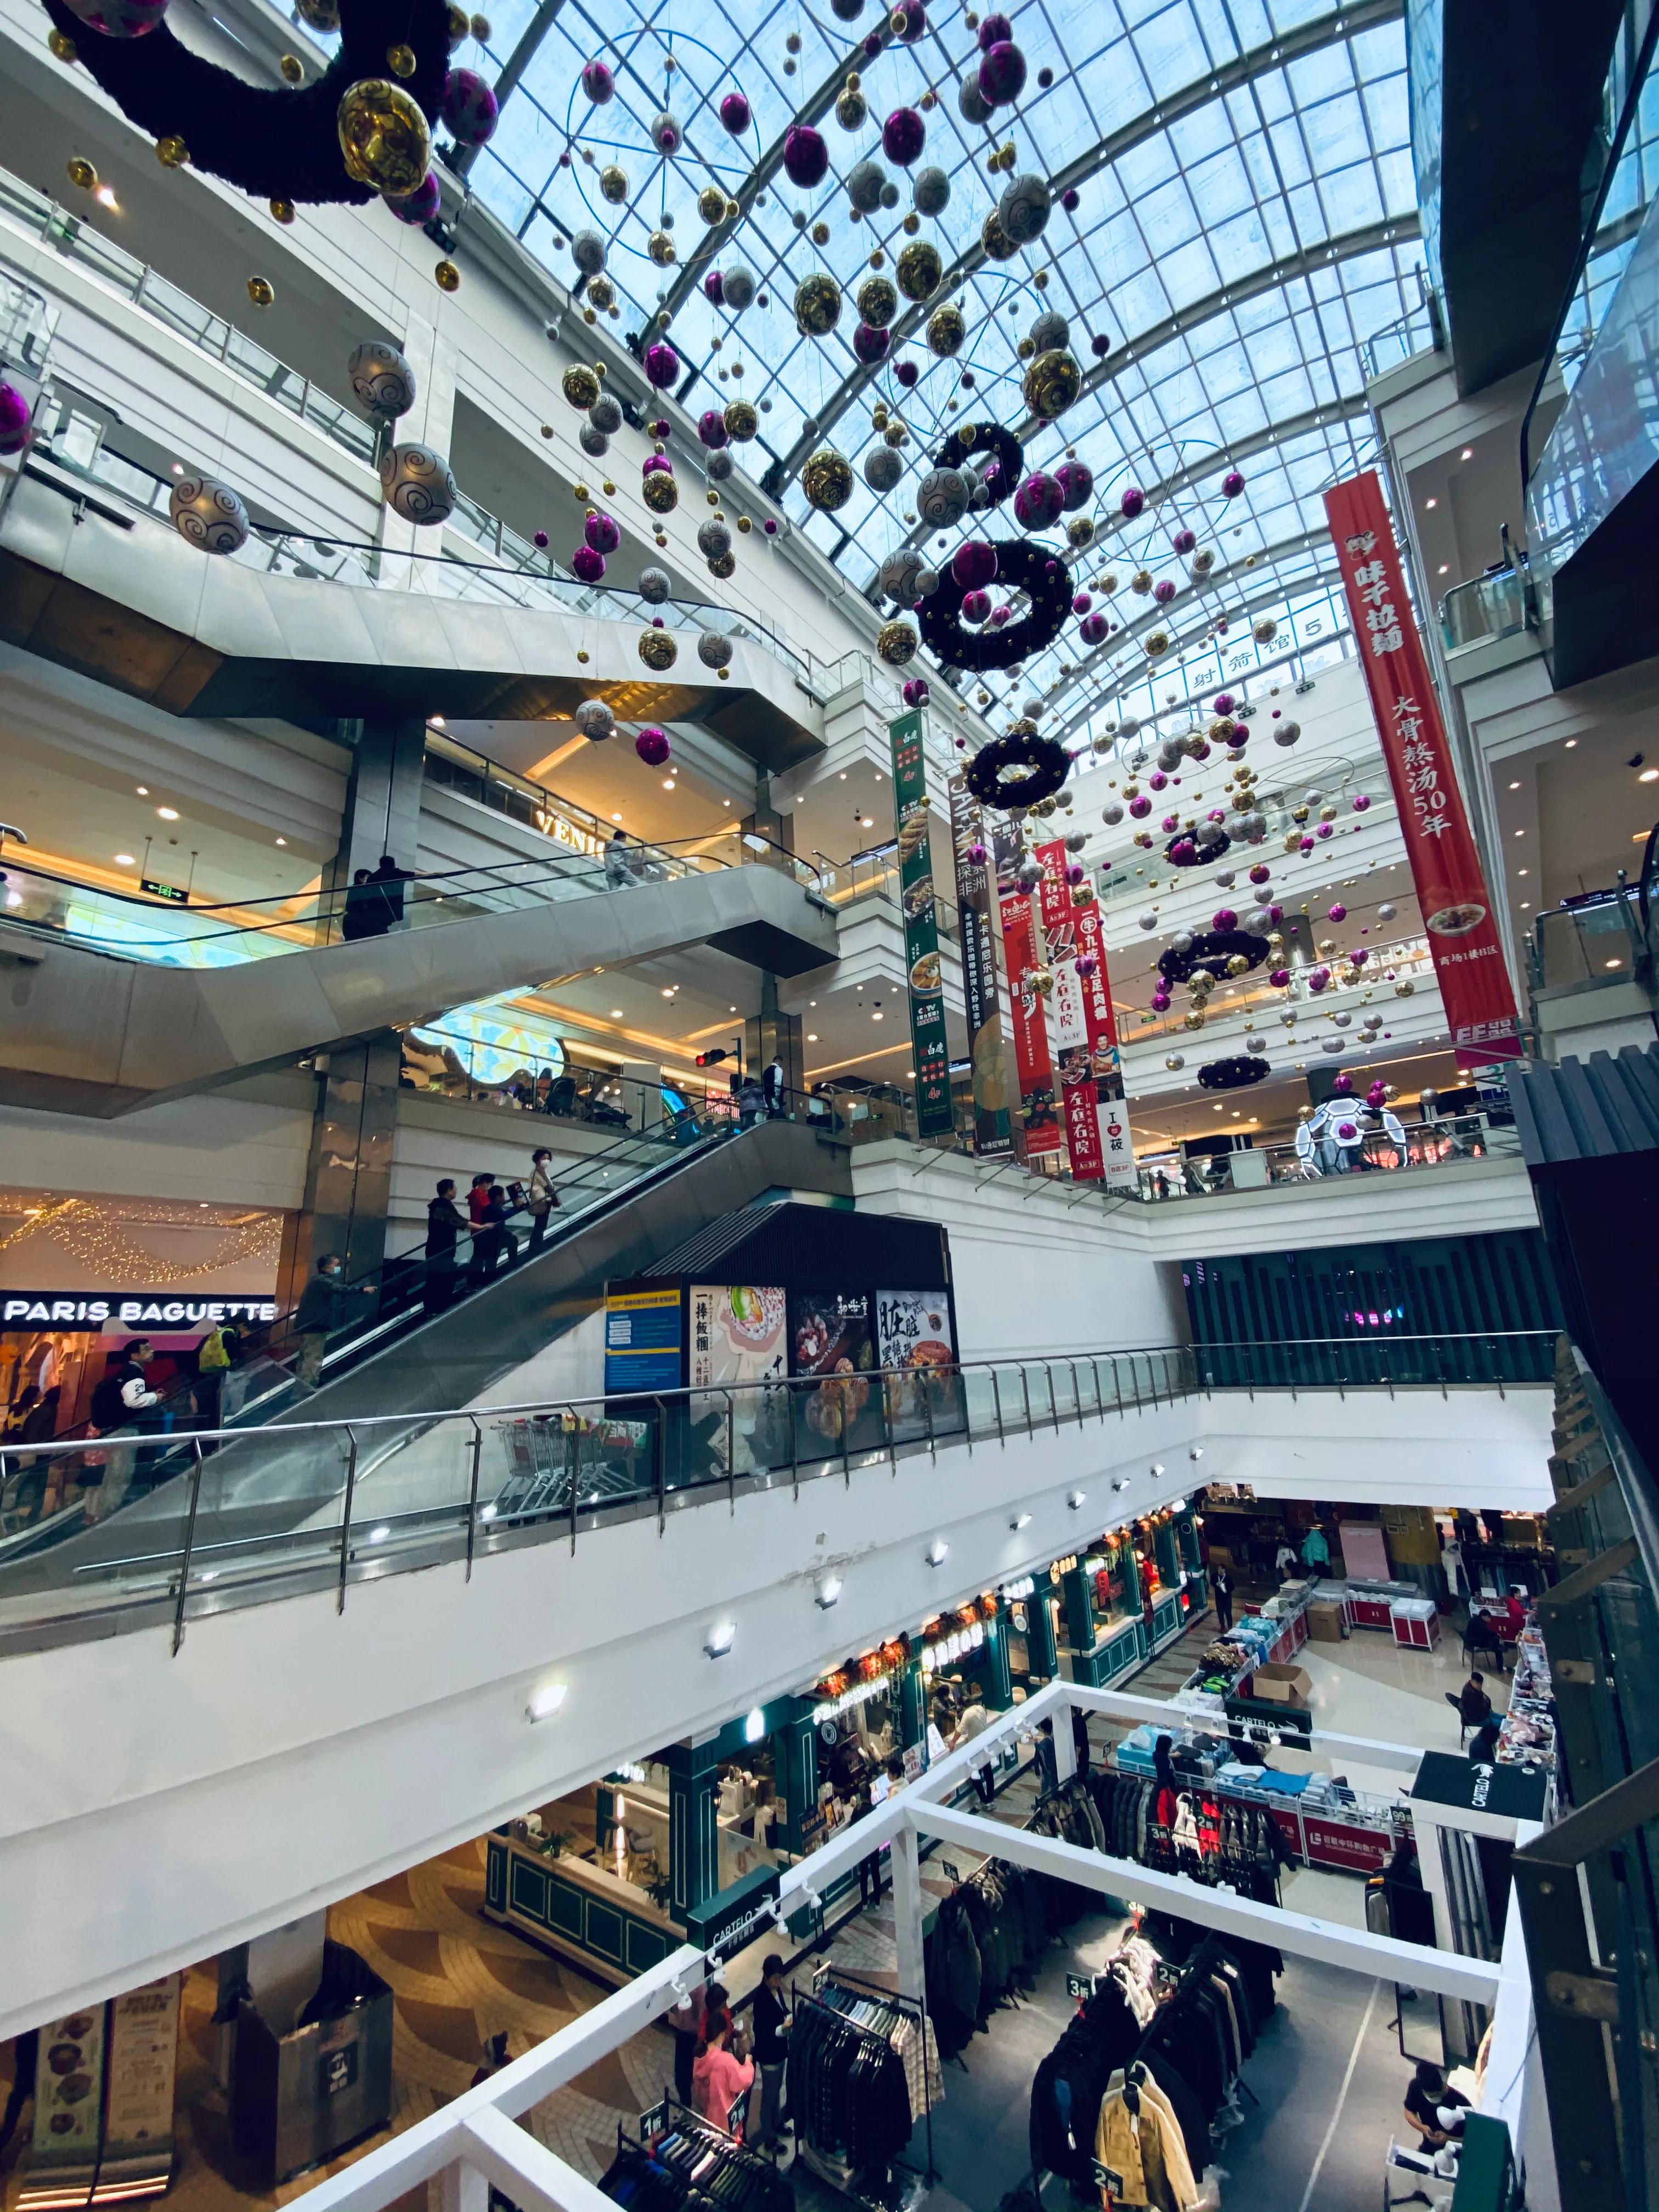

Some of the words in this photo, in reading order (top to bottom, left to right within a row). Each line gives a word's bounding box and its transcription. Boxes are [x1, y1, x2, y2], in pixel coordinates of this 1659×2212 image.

[1194, 606, 1347, 687] 射箭馆5
[1391, 696, 1452, 838] 大骨熬汤50年
[958, 875, 986, 896] 非洲
[5, 1300, 109, 1321] PARIS
[120, 1301, 276, 1321] BAGUETTE
[1471, 1778, 1490, 1807] CARTELO
[714, 1910, 753, 1945] CARTELO
